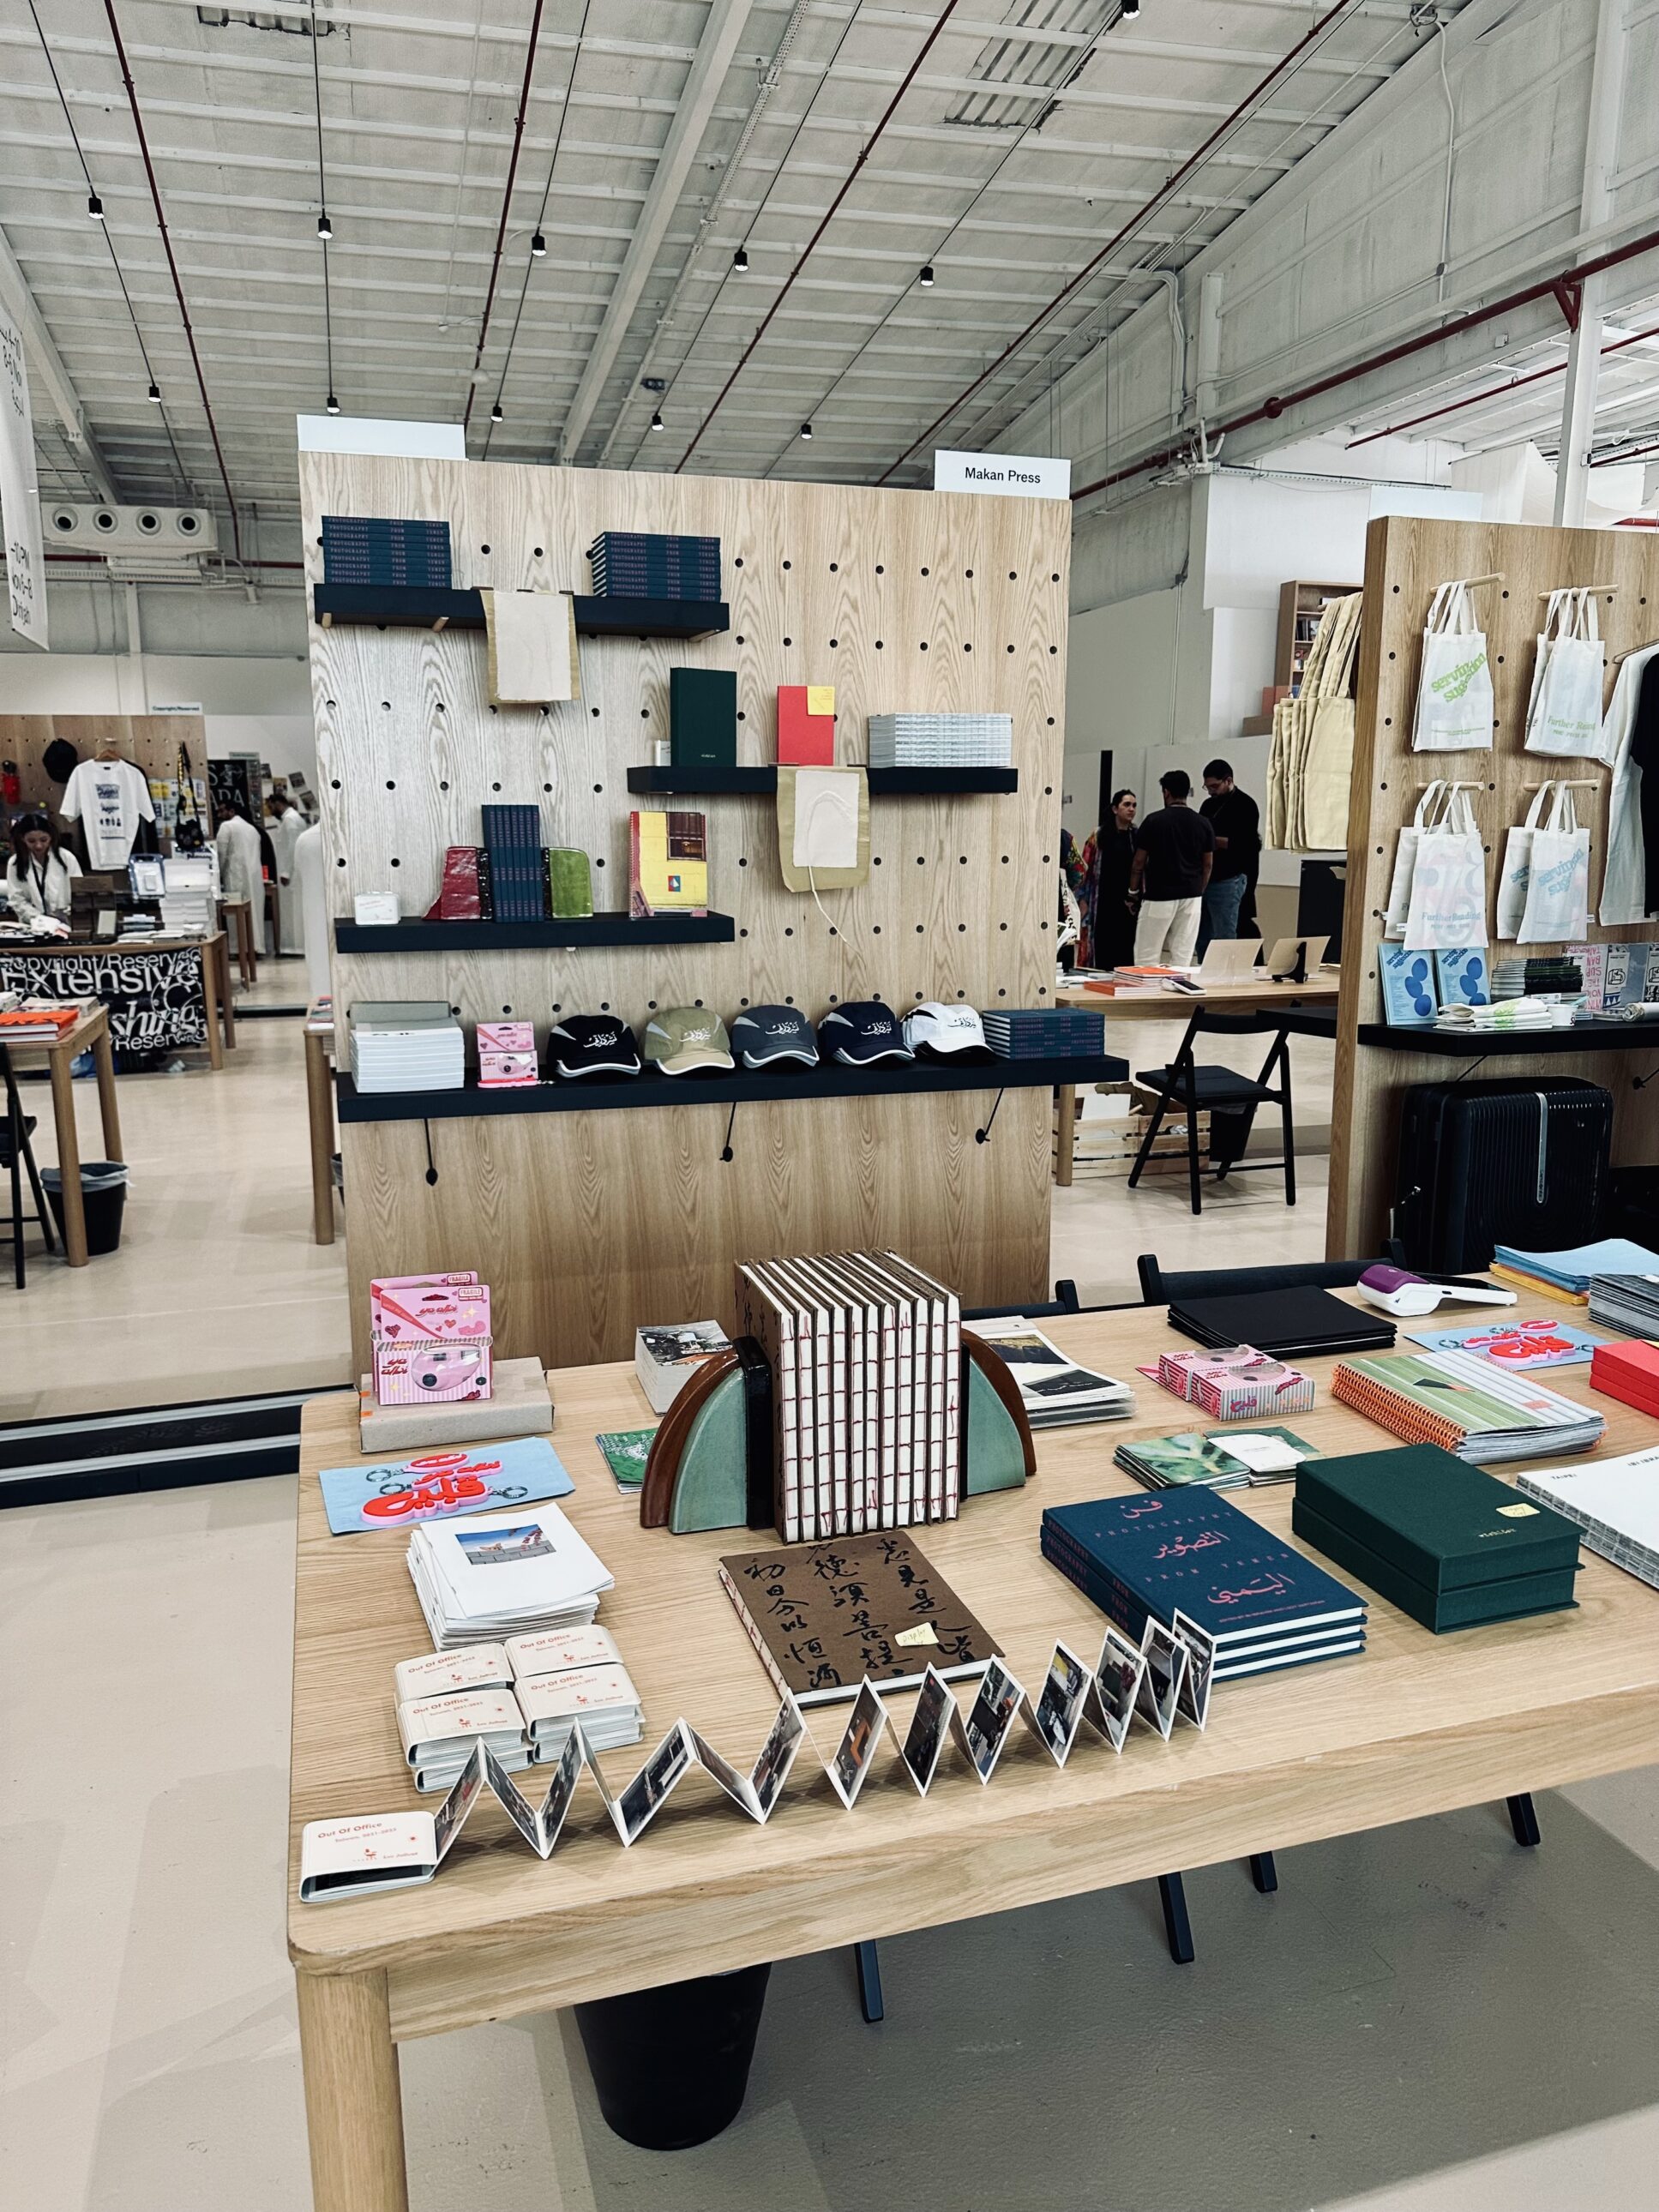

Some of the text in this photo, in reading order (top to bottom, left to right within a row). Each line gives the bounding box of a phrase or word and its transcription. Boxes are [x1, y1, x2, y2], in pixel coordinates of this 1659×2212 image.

[965, 467, 1041, 484] Makan Press
[363, 1475, 487, 1518] قلبي
[1120, 1500, 1163, 1518] فن
[1095, 1512, 1232, 1538] PHOTOGRAPHY
[1048, 1519, 1089, 1561] PHOTOGRAPHY
[1145, 1553, 1289, 1583] FROM YEMEN
[548, 1634, 571, 1643] Office
[437, 1654, 462, 1663] Office
[559, 1674, 584, 1683] Office
[443, 1698, 469, 1706] Office
[353, 1822, 382, 1831] Office
